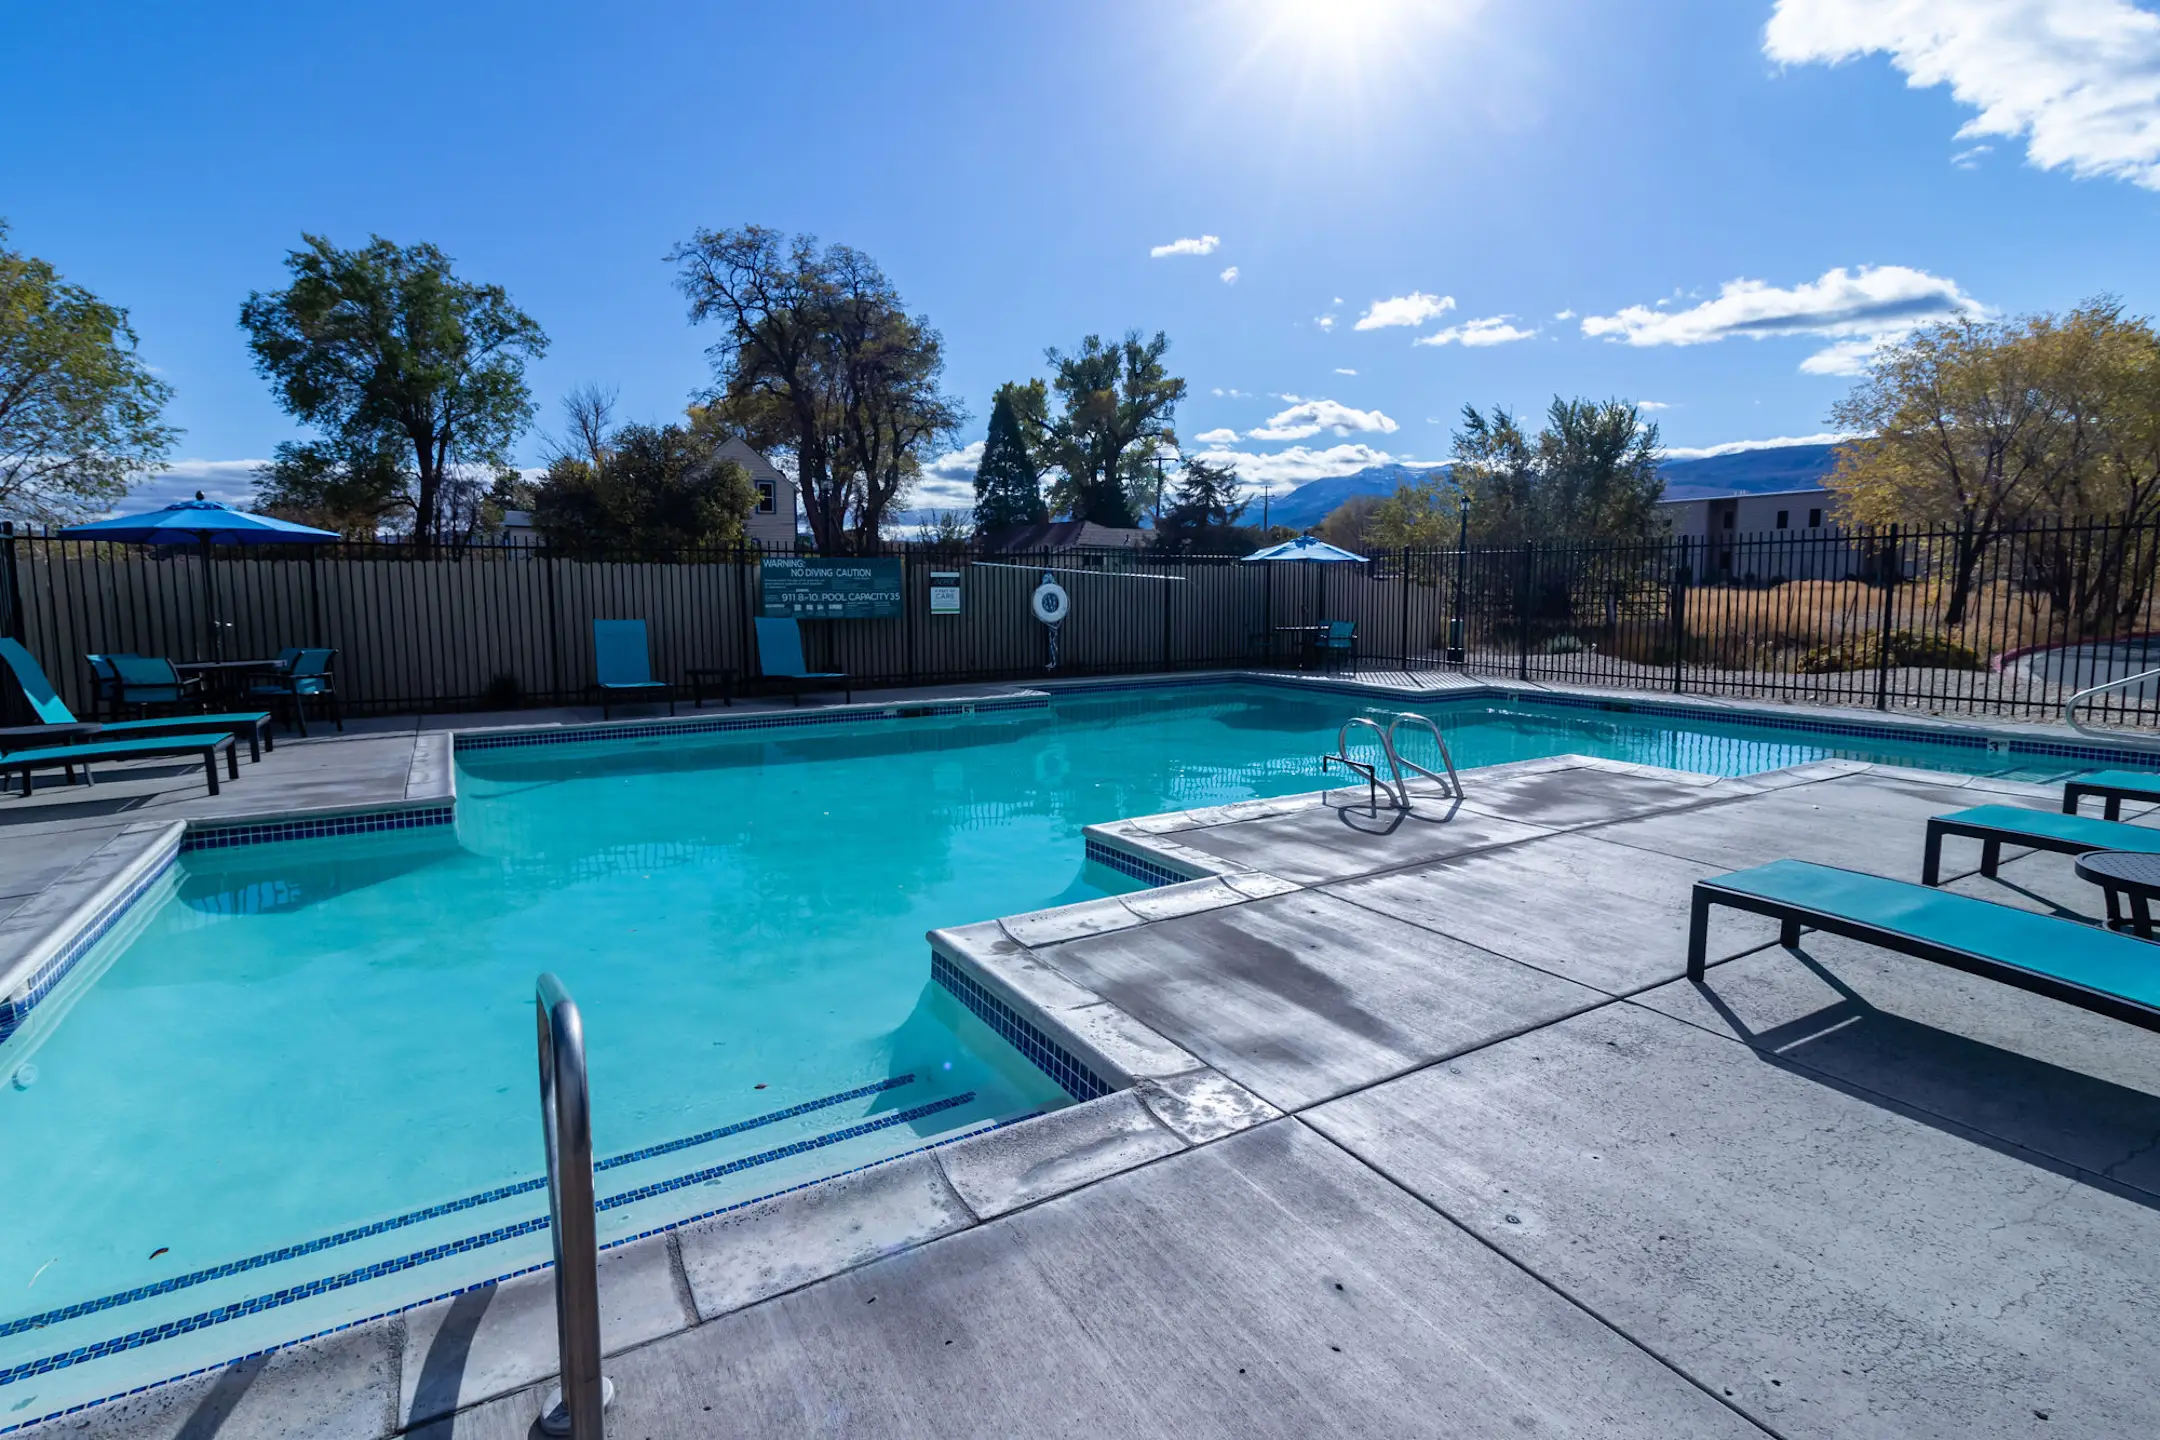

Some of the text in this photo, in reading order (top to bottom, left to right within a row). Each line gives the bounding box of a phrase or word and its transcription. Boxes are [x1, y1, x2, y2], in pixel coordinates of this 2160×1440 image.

[762, 559, 806, 568] WARNING:
[791, 568, 833, 577] NO DIVING
[836, 568, 872, 577] CAUTION
[781, 593, 796, 602] 911
[822, 592, 847, 601] POOL
[848, 592, 889, 601] CAPACITY
